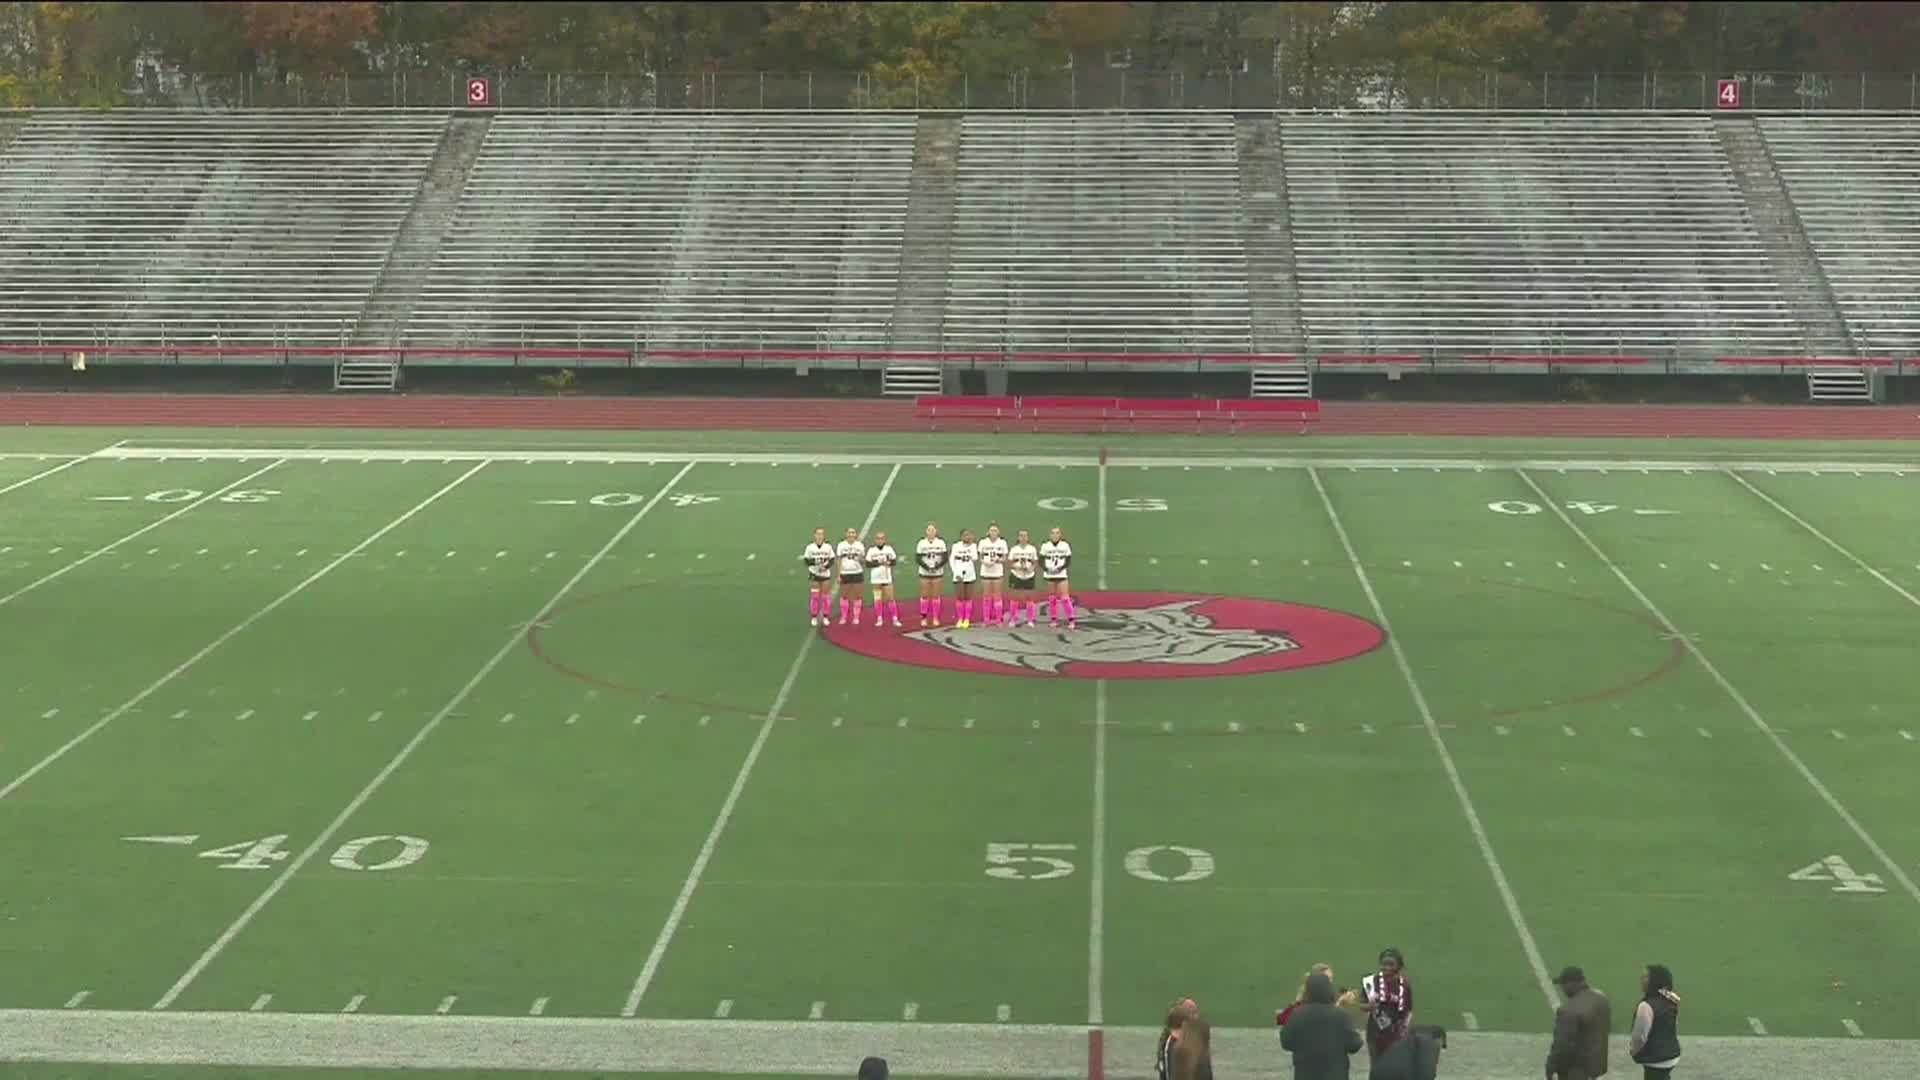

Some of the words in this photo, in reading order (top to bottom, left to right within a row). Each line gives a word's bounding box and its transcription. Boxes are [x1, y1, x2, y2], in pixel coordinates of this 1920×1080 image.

[471, 81, 485, 101] 3
[1721, 84, 1736, 103] 4
[984, 842, 1215, 882] 50
[1787, 855, 1888, 893] 4
